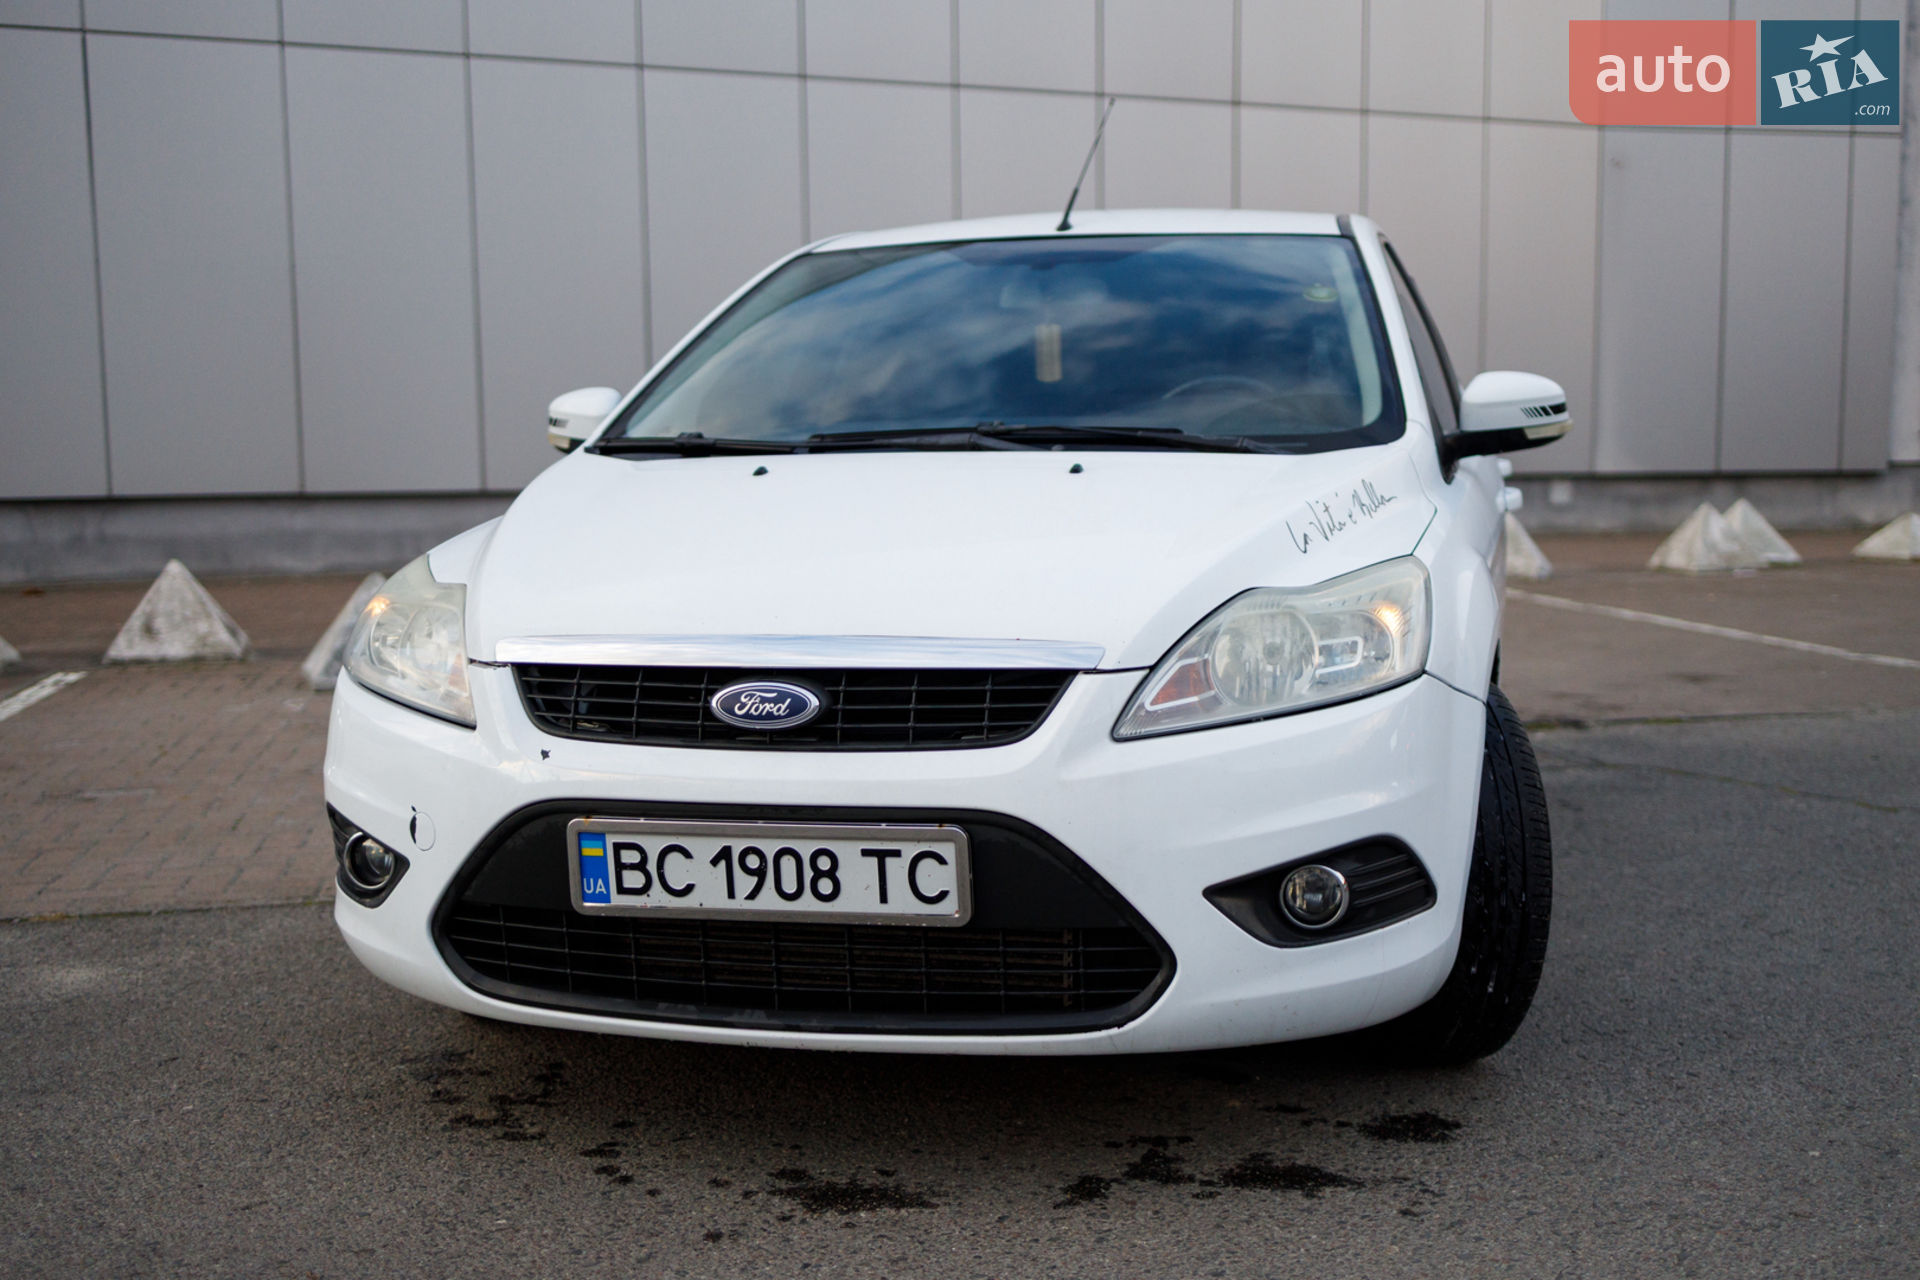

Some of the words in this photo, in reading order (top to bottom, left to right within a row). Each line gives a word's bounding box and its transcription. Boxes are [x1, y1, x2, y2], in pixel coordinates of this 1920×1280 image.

[734, 691, 791, 716] Ford
[612, 841, 696, 898] BC
[709, 844, 841, 903] 1908
[860, 848, 951, 905] TC
[583, 877, 607, 895] UA
